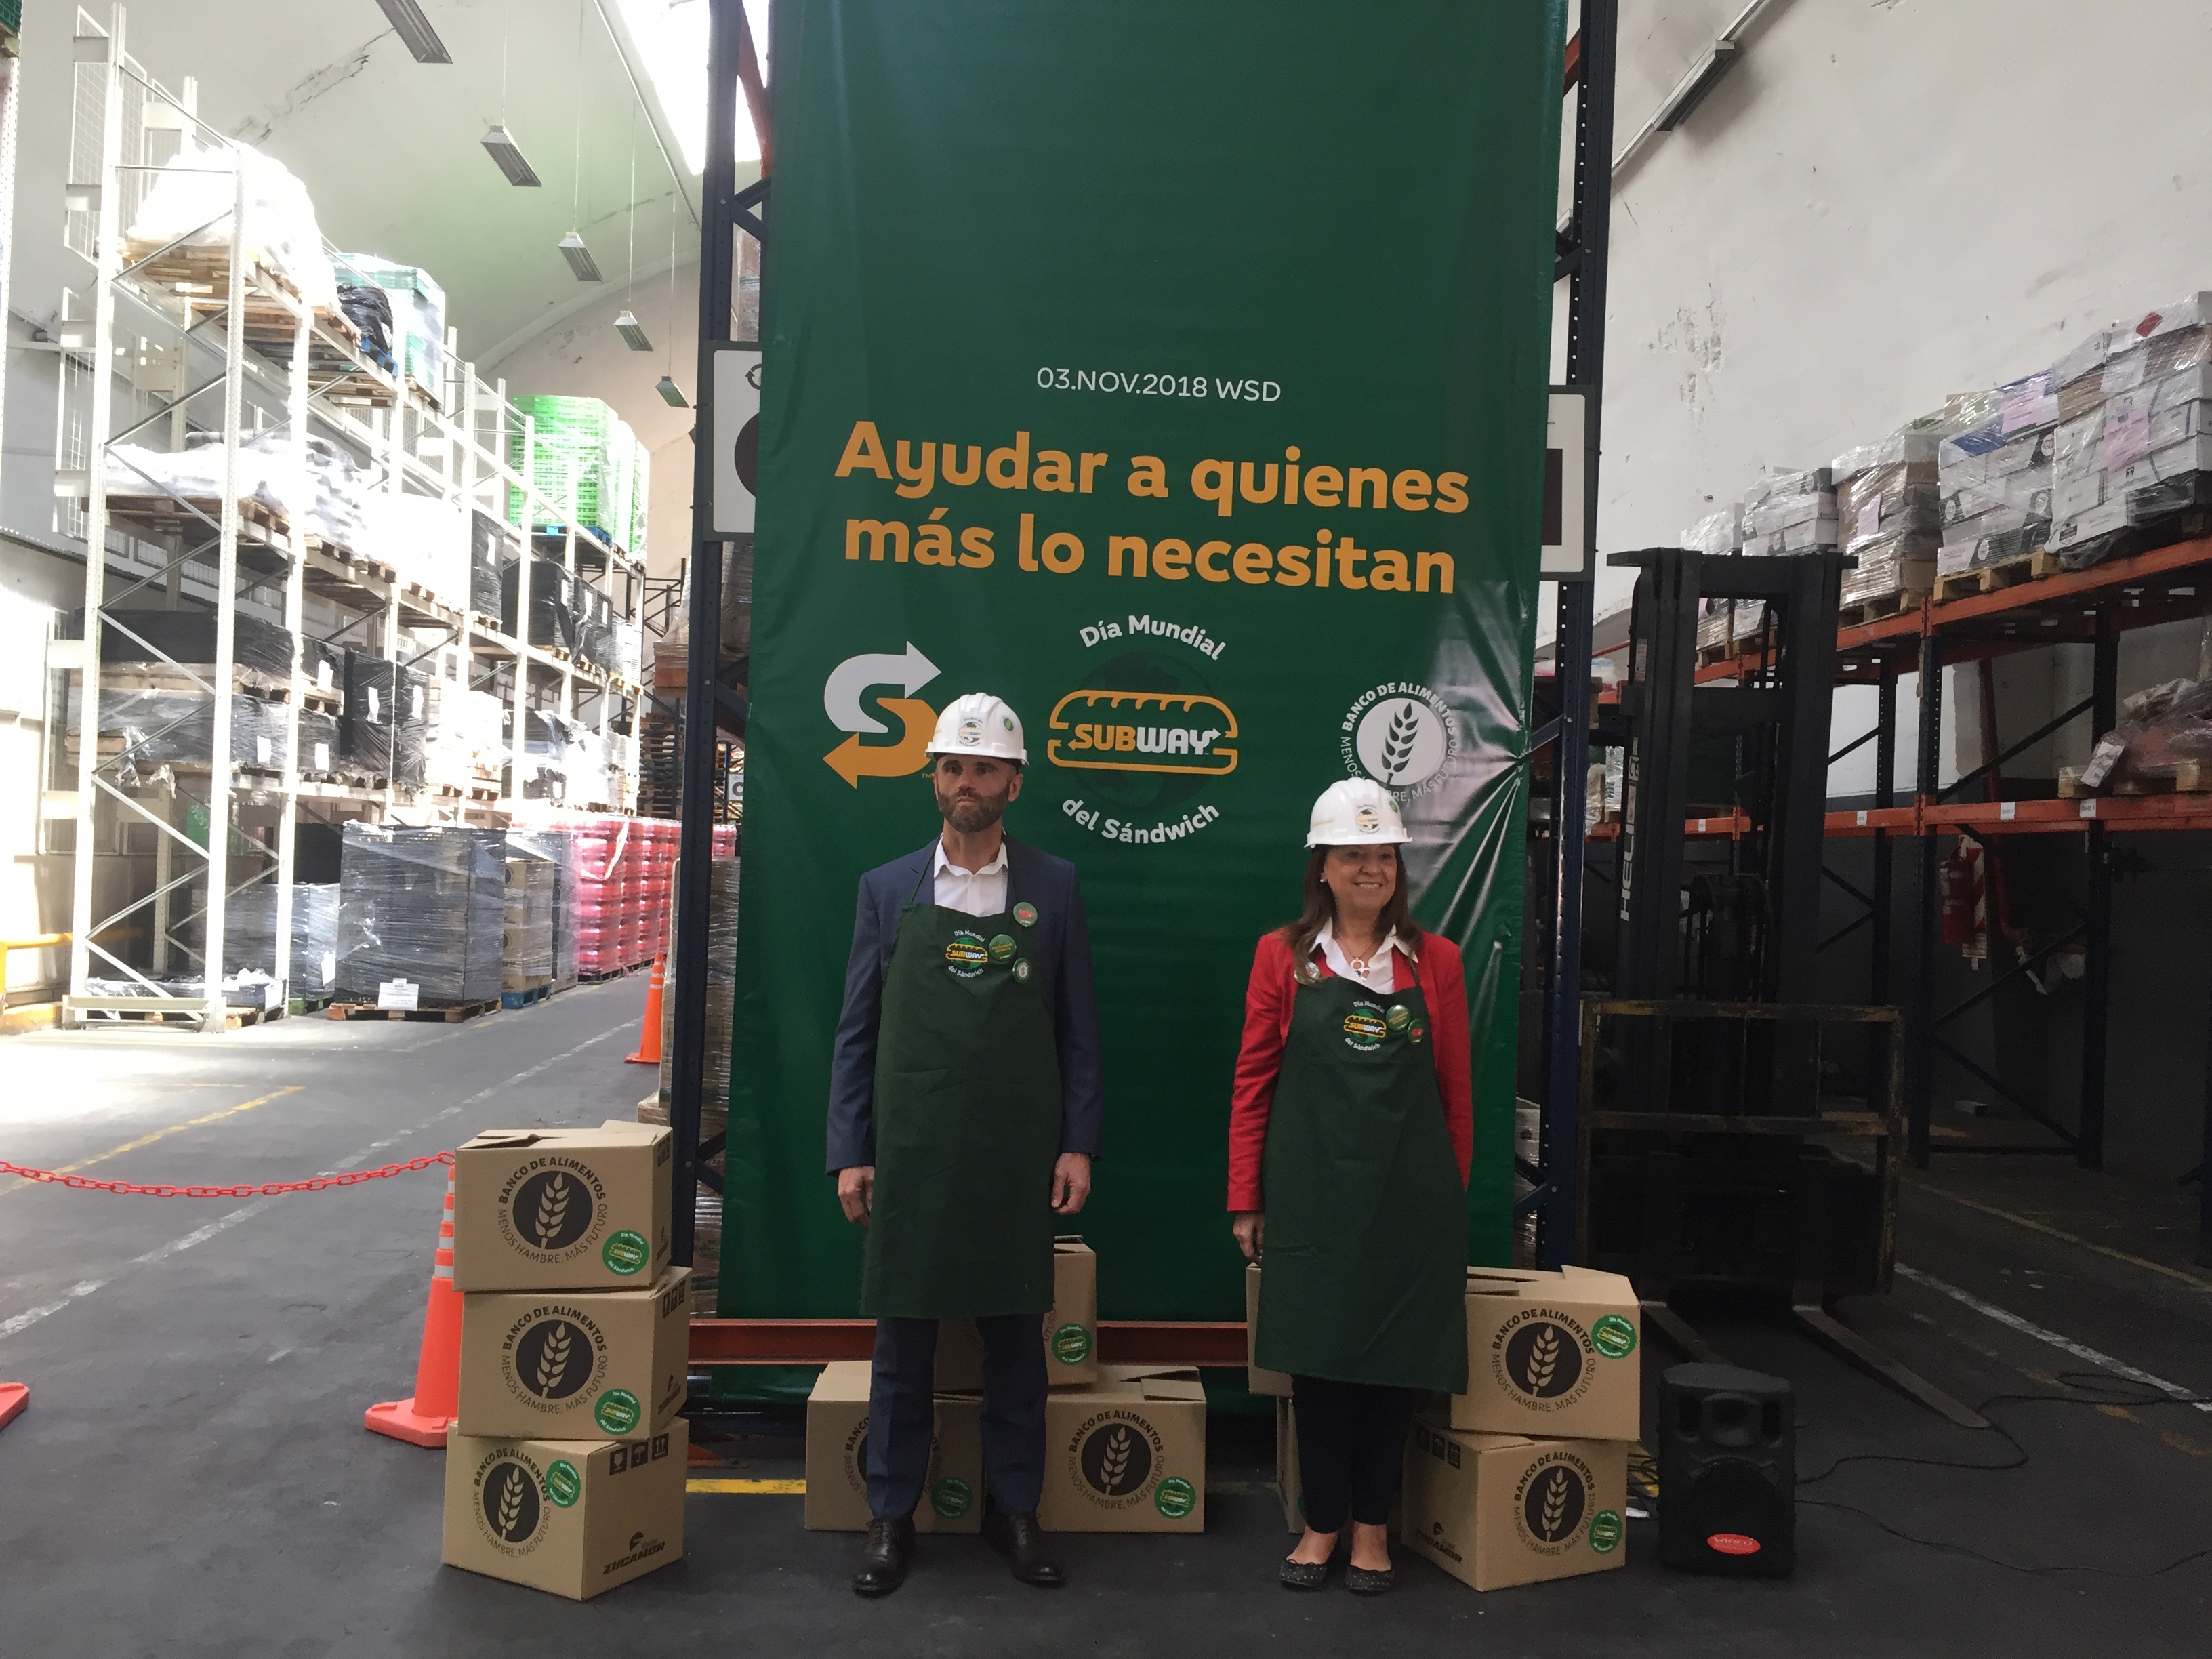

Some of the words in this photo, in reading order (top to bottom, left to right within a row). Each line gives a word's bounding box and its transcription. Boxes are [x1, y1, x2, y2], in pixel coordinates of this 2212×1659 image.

[1036, 367, 1208, 398] 03.NOV.2018
[1215, 377, 1282, 403] WSD
[834, 421, 1107, 498] Ayudar
[1126, 453, 1169, 498] a
[1190, 445, 1469, 516] quienes
[844, 507, 995, 569] más
[1019, 513, 1085, 574] lo
[1107, 529, 1456, 594] necesitan
[1079, 620, 1122, 648] Día
[1128, 615, 1227, 661] Mundial
[1341, 690, 1376, 732] BANCO
[1376, 682, 1396, 697] DE
[1397, 682, 1458, 736] ALIMENTOS
[1067, 723, 1221, 756] SUBWAY
[1340, 736, 1363, 778] MENOS
[1062, 798, 1101, 831] del
[1101, 804, 1221, 844] Sándwich
[950, 949, 985, 960] SUBWAY
[498, 1166, 529, 1204] BANCO
[529, 1158, 547, 1170] DE
[549, 1156, 607, 1200] ALIMENTOS
[497, 1209, 518, 1247] MENOS
[586, 1203, 607, 1246] FUTURO
[502, 1313, 532, 1351] BANCO
[533, 1305, 550, 1318] DE
[552, 1305, 607, 1351] ALIMENTOS
[1492, 1315, 1521, 1350] BANCO
[1521, 1309, 1538, 1320] DE
[1540, 1309, 1595, 1354] ALIMENTOS
[501, 1355, 520, 1393] MENOS
[586, 1355, 608, 1397] FUTURO
[1492, 1353, 1511, 1391] MENOS
[1574, 1358, 1597, 1398] FUTURO
[1069, 1418, 1095, 1452] BANCO
[1096, 1410, 1111, 1422] DE
[1113, 1410, 1164, 1452] ALIMENTOS
[474, 1452, 495, 1487] BANCO
[495, 1447, 508, 1458] DE
[509, 1448, 550, 1502] ALIMENTOS
[1514, 1463, 1537, 1502] BANCO
[1537, 1453, 1551, 1467] DE
[1553, 1452, 1595, 1490] ALIMENTOS
[473, 1492, 486, 1531] MENOS
[534, 1505, 552, 1547] FUTURO
